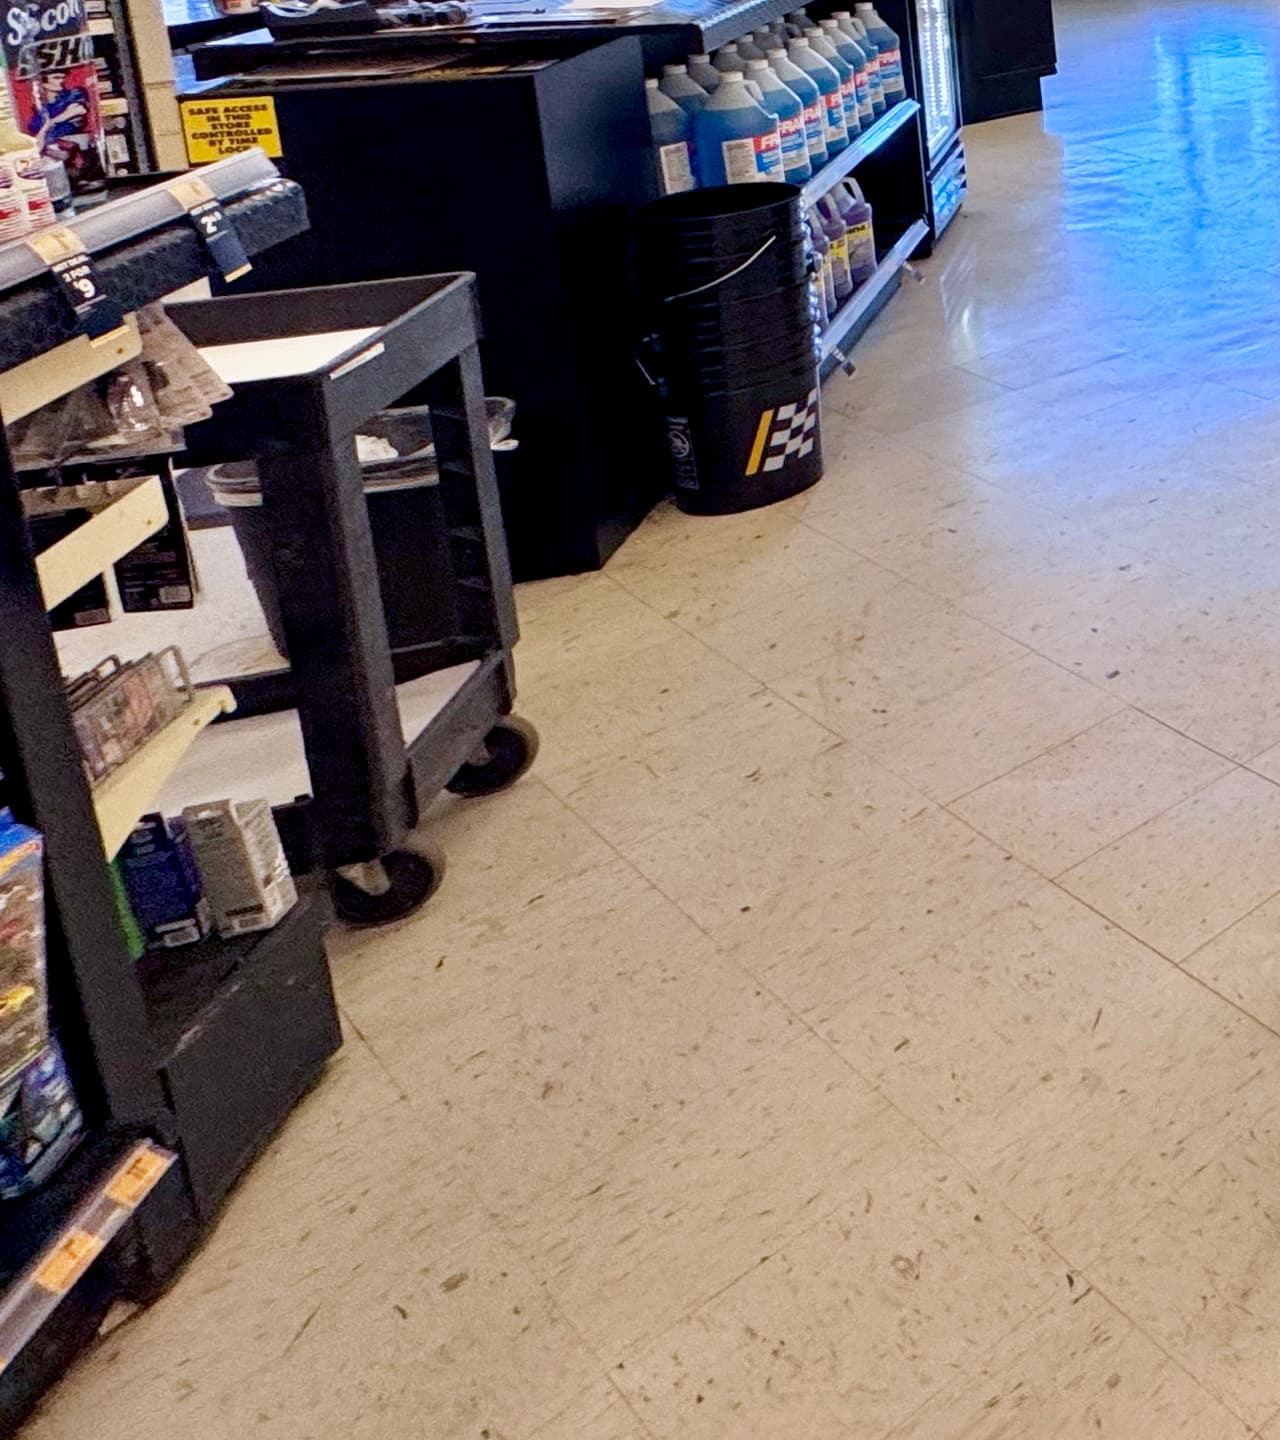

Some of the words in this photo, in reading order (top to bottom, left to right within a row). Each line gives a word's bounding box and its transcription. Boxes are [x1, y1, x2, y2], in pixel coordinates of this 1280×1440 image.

[188, 107, 219, 116] SAFE
[223, 103, 268, 113] ACCESS
[224, 113, 252, 121] THIS
[211, 121, 250, 130] STORE
[191, 127, 273, 140] CONTROLLED
[228, 136, 258, 146] TIME
